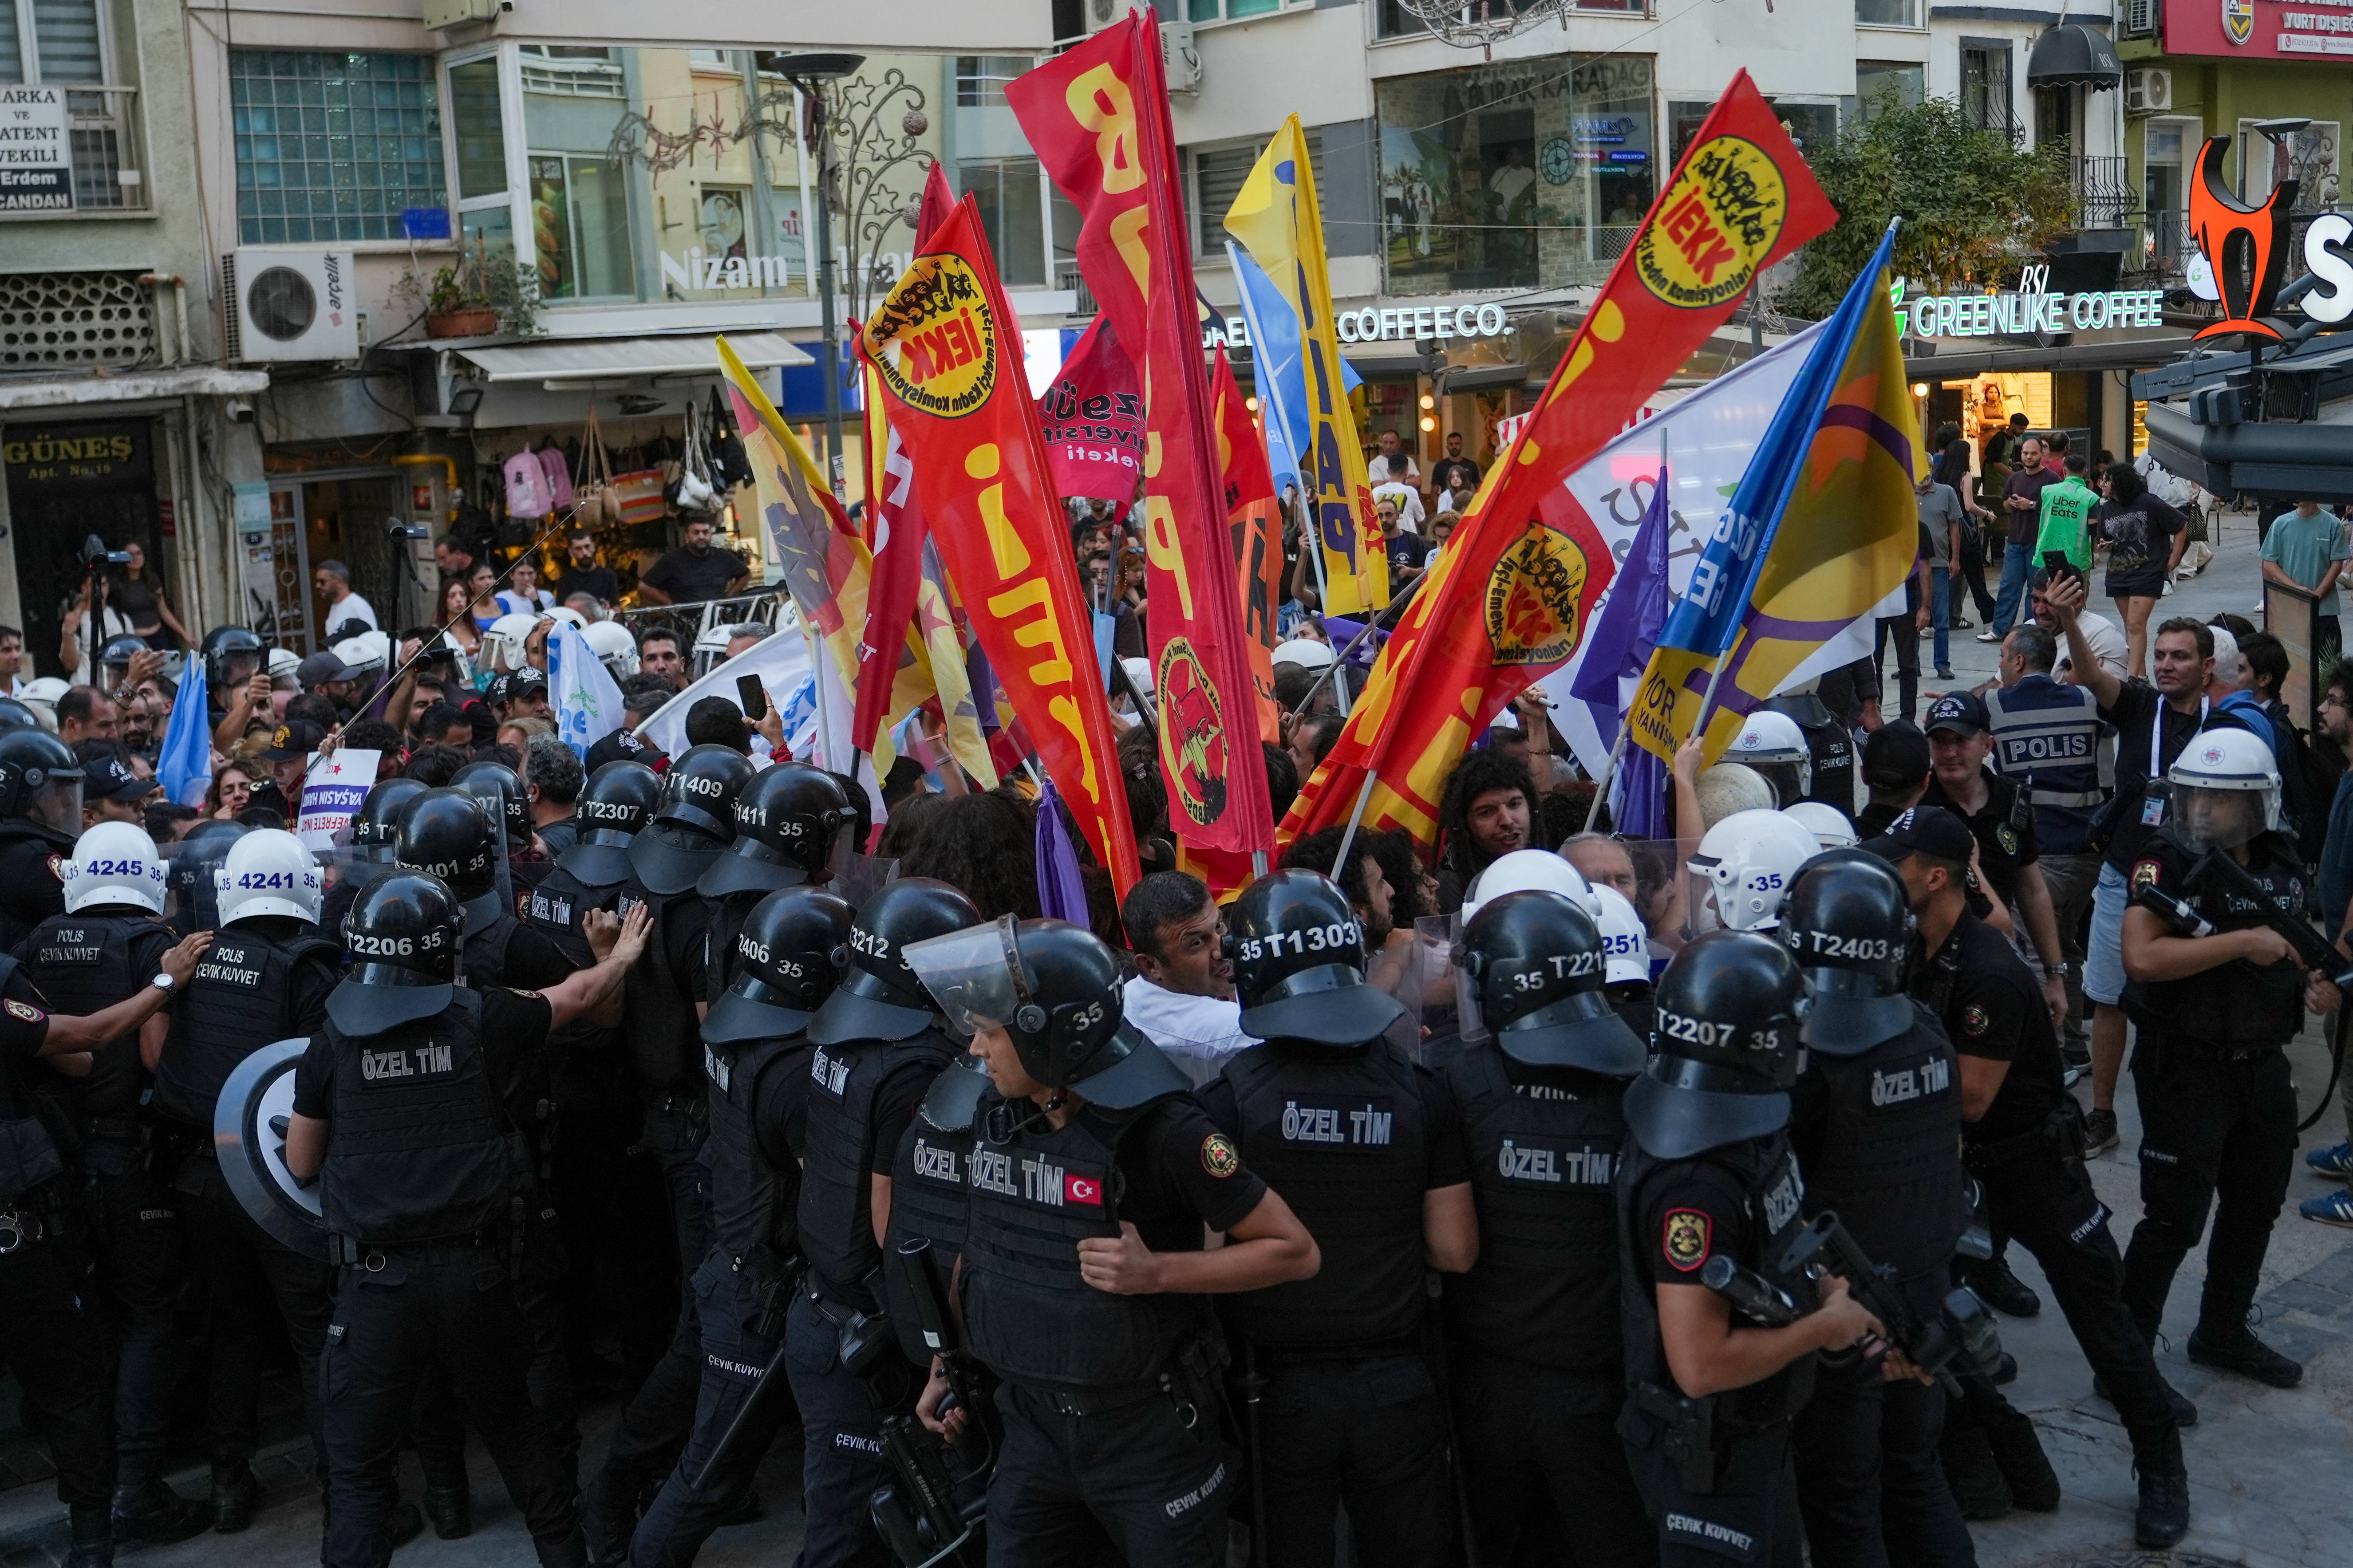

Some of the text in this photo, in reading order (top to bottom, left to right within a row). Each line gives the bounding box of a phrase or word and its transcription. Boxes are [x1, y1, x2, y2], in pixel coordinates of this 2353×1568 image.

[2283, 12, 2316, 30] YURT
[0, 91, 56, 103] ARKA
[14, 111, 30, 120] VE
[1, 170, 58, 186] Erdem
[328, 251, 340, 310] arçelik
[659, 246, 788, 292] Nizam
[1338, 306, 1453, 343] COFFEE
[1915, 290, 2163, 337] GREENLIKE COFFEE
[4, 433, 134, 464] GÜNEŞ
[28, 467, 58, 480] Apt.
[2050, 506, 2078, 519] Eats
[2053, 495, 2081, 508] Uber
[669, 772, 723, 798] T1409
[318, 788, 363, 806] YAŞASIN
[507, 802, 521, 816] 35
[586, 801, 640, 821] T2307
[734, 804, 767, 826] 1411
[359, 823, 370, 835] 35
[779, 822, 803, 836] 35
[87, 860, 143, 876] 4245
[150, 867, 162, 881] 35
[469, 854, 485, 871] 35
[238, 872, 294, 890] 4241
[304, 873, 315, 887] 35
[531, 890, 571, 926] ÖZEL TİM
[347, 931, 441, 956] T2206 35
[738, 932, 770, 963] 2406
[1240, 922, 1357, 962] 35 T1303
[1602, 933, 1640, 955] 251
[1810, 930, 1888, 960] T2403
[63, 947, 100, 962] KUVVET
[220, 965, 260, 986] KUVVET
[776, 959, 804, 978] 35
[1514, 971, 1544, 993] 35
[1072, 1001, 1104, 1032] 35
[1656, 1007, 1779, 1050] T2207 35
[361, 1041, 452, 1080] ÖZEL TİM
[811, 1045, 849, 1096] ÖZEL TİM
[715, 1056, 729, 1093] TİM
[1871, 1056, 1950, 1107] ÖZEL TİM
[1282, 1100, 1392, 1145] ÖZEL TİM
[913, 1138, 960, 1183] ÖZEL
[1498, 1139, 1611, 1184] ÖZEL TİM
[971, 1140, 1017, 1198] ÖZEL
[1022, 1154, 1064, 1207] TİM
[734, 1362, 764, 1379] KUVV
[1704, 1522, 1753, 1552] KUVVET
